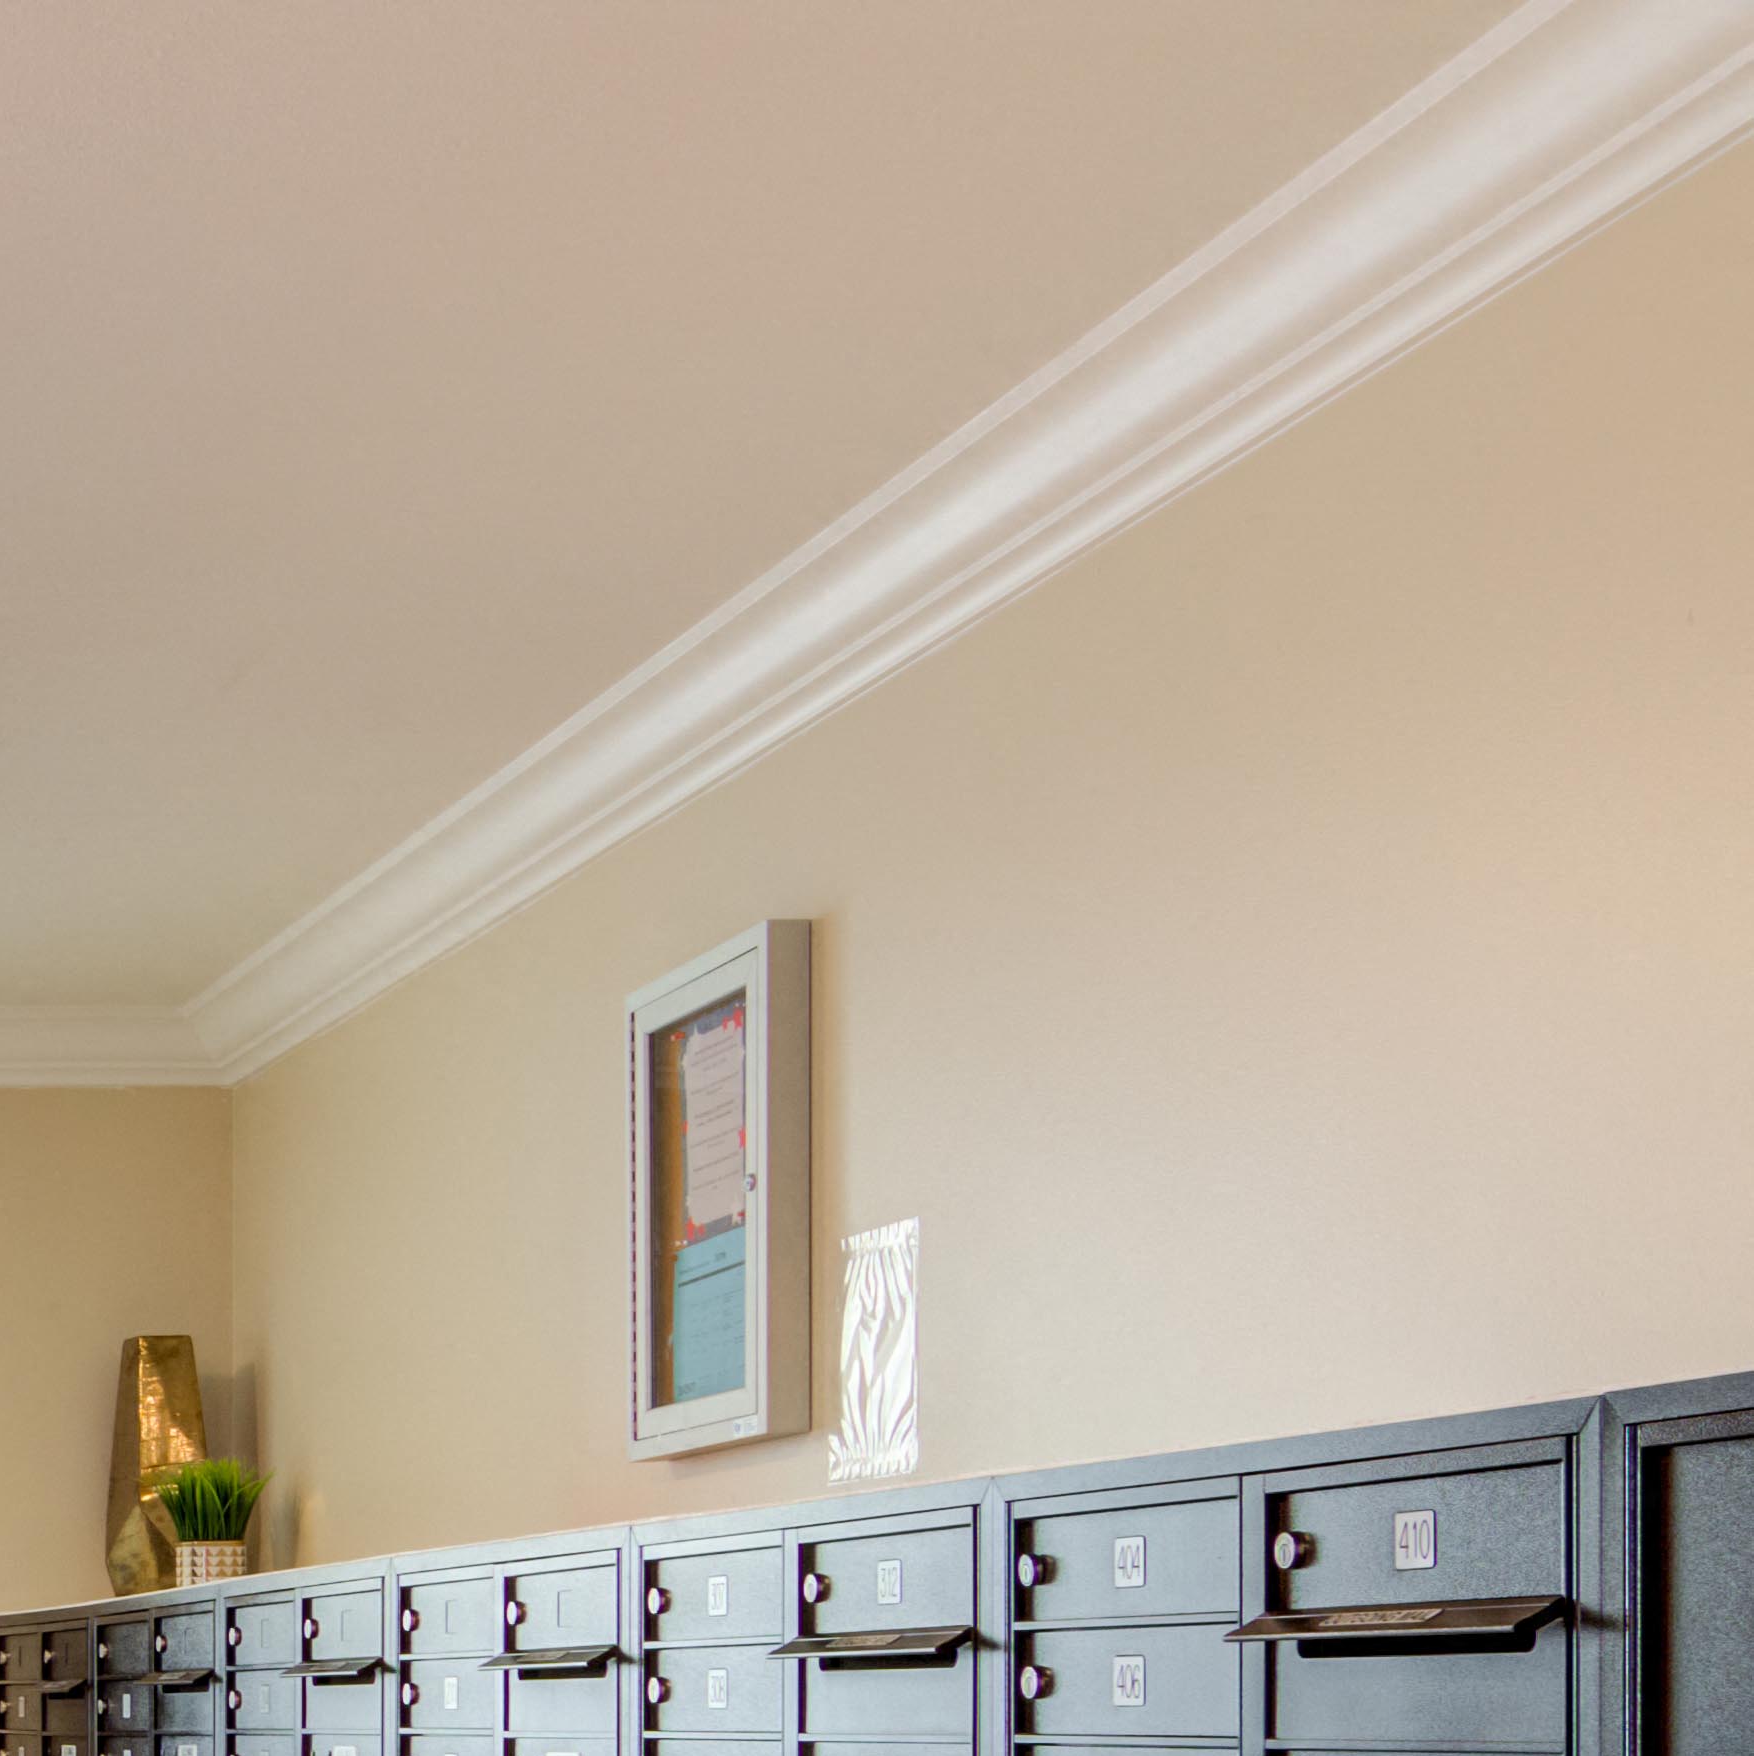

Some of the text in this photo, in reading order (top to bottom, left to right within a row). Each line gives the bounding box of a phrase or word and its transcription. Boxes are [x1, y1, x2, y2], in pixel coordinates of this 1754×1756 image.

[1399, 1519, 1431, 1560] 410
[1117, 1543, 1141, 1580] 404
[1116, 1663, 1141, 1699] 406
